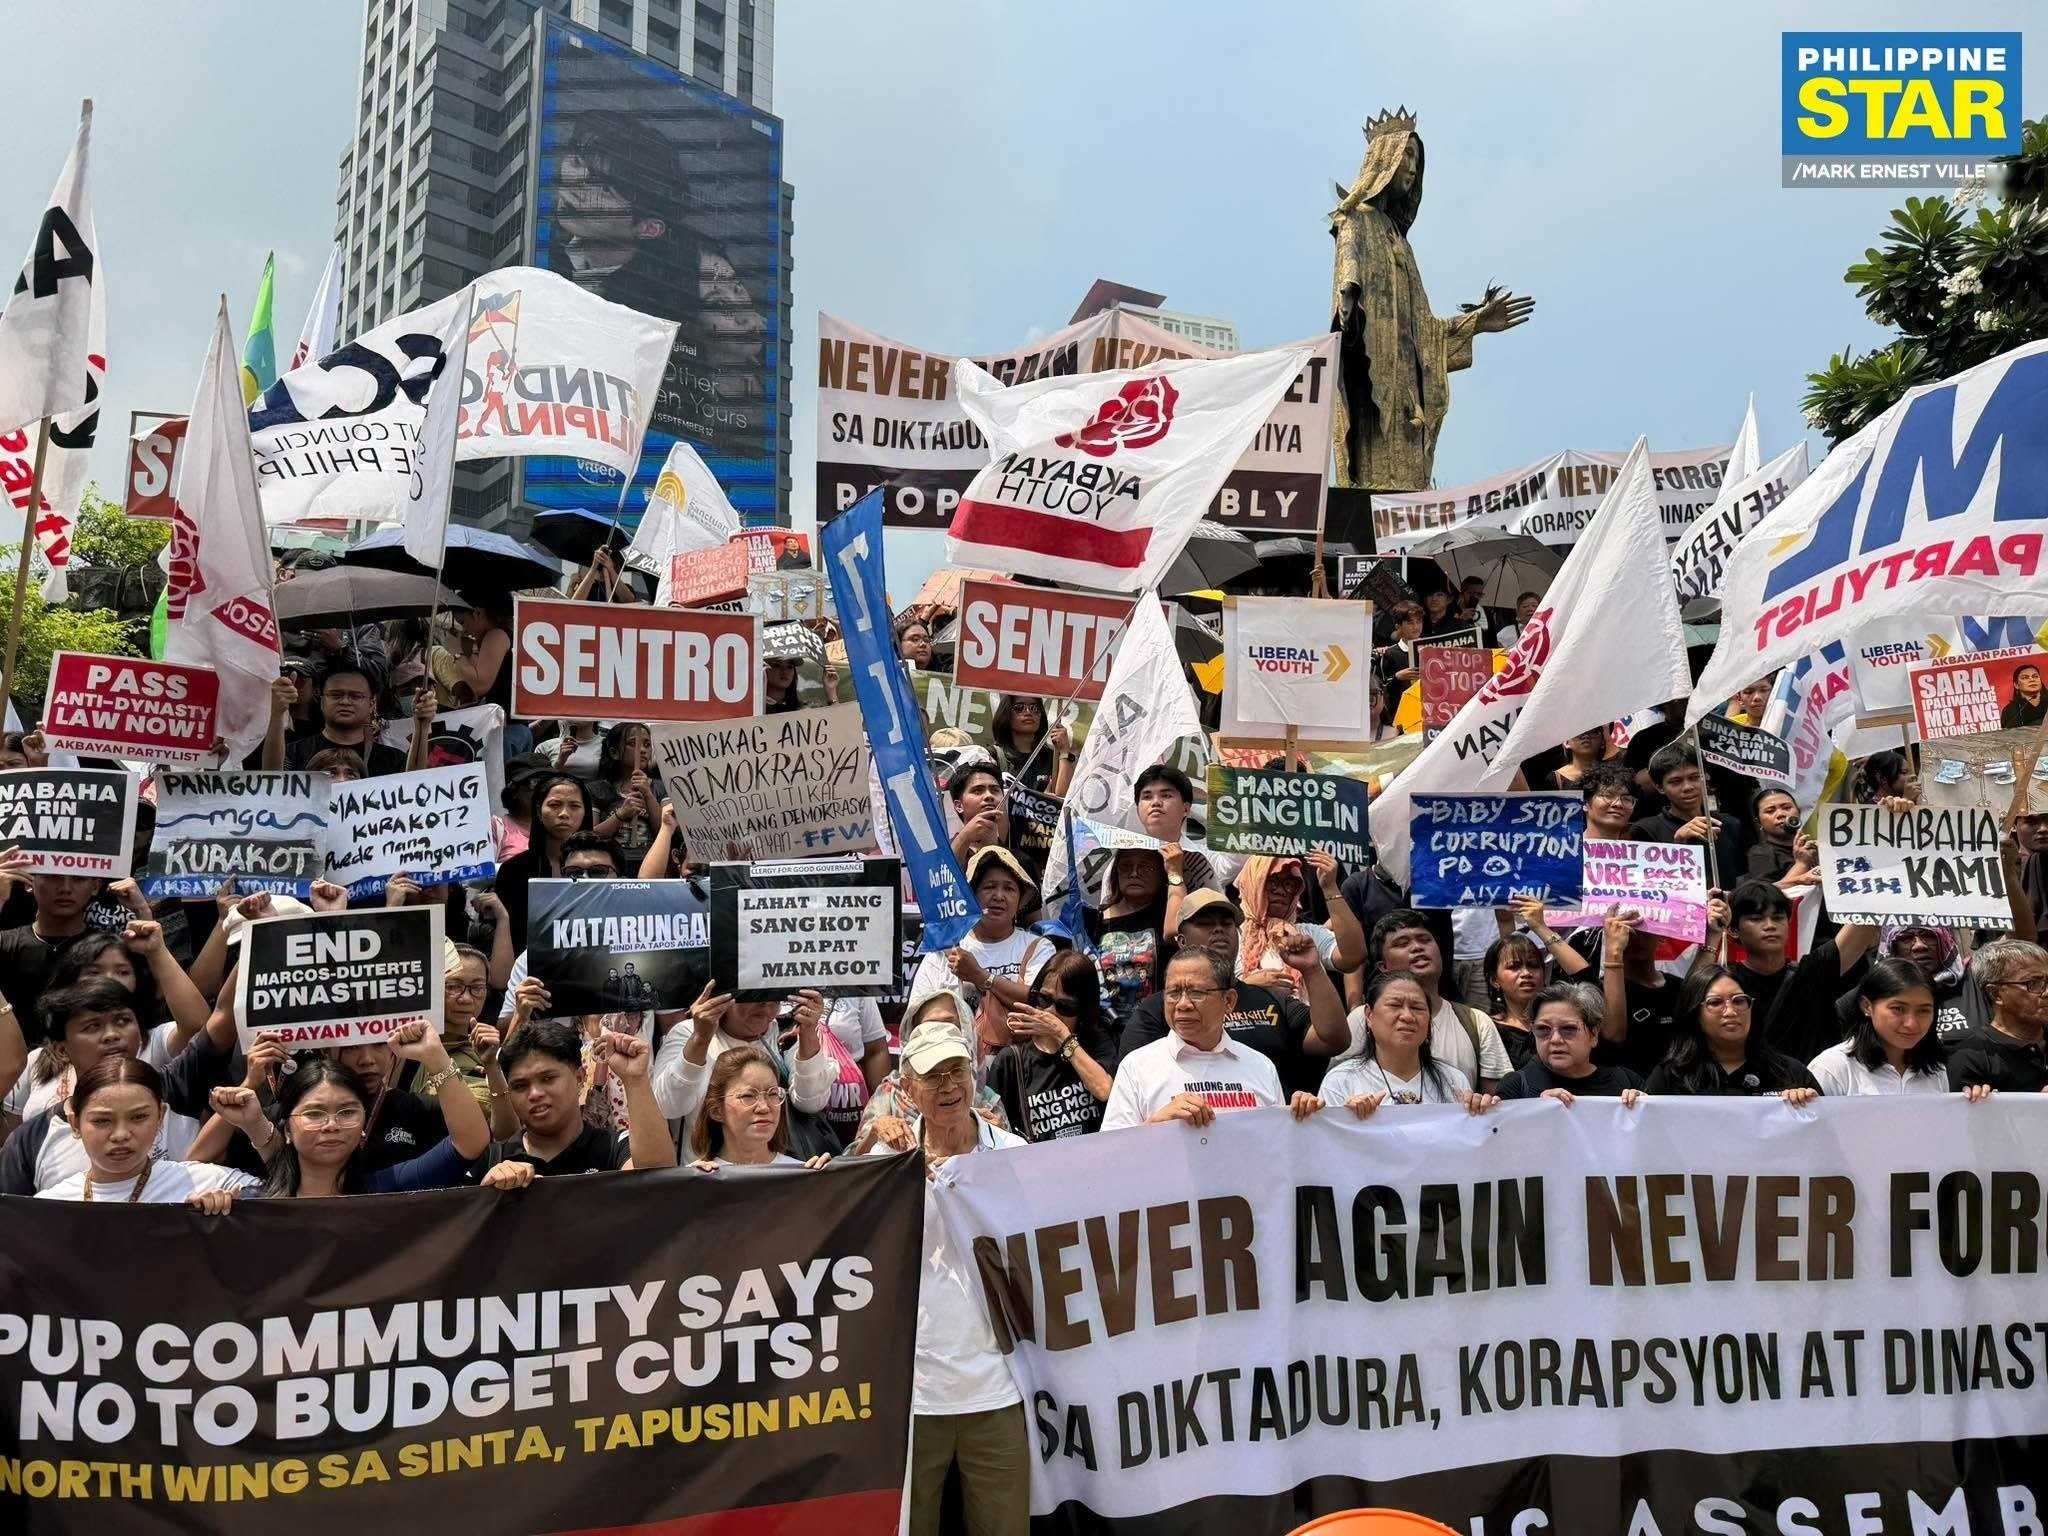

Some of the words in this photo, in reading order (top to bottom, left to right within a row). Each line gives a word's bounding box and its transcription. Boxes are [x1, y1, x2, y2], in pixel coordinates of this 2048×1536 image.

[818, 337, 950, 401] NEVER
[657, 412, 705, 435] SEPTEMBER
[690, 393, 748, 429] Yours
[832, 412, 864, 444] SA
[872, 416, 989, 451] DIKTADU
[1373, 501, 1456, 539] NEVER
[1465, 471, 1549, 519] AGAIN
[963, 600, 1128, 682] SENTR
[1248, 645, 1320, 662] LIBERAL
[1861, 640, 1924, 659] LIBERAL
[521, 621, 749, 704] SENTRO
[1254, 659, 1313, 674] YOUTH
[1868, 651, 1920, 668] YOUTH
[1931, 653, 1990, 668] AKBAYAN
[1993, 645, 2034, 659] PARTY
[86, 664, 189, 700] PASS
[1917, 667, 1995, 700] SARA,
[54, 691, 212, 719] ANTI-DYNASTY
[1921, 690, 1997, 711] IPALIWANAG
[55, 707, 120, 730] LAW
[125, 714, 206, 739] NOW!
[1923, 708, 1956, 729] MO
[1959, 702, 2000, 725] ANG
[661, 725, 768, 768] HUNGKAG
[777, 718, 828, 750] ANG
[1701, 718, 1786, 751] BINABAHA
[1718, 734, 1735, 747] PA
[1739, 739, 1764, 751] RIN
[1927, 723, 1977, 739] BILYONES
[54, 739, 124, 754] AKBAYAN
[127, 747, 200, 762] PARTYLIST
[1709, 739, 1775, 764] KAMI!
[669, 746, 860, 809] DEMOKRASYA
[1704, 752, 1746, 772] KBAYAN
[1750, 765, 1786, 781] YOUTH
[0, 782, 118, 803] NABAHA
[162, 774, 311, 799] PANAGUTIN
[1237, 776, 1337, 800] MARCOS
[35, 801, 77, 816] RIN
[685, 824, 720, 843] KUNG
[721, 814, 779, 841] WALANG
[782, 795, 872, 827] DEMOKRASYA
[1216, 795, 1359, 833] SINGILIN
[1431, 798, 1507, 825] BABY
[1511, 799, 1581, 829] STOP
[0, 816, 96, 842] AMI!
[1829, 807, 2002, 852] BINABAHA
[1430, 830, 1581, 859] CORRUPTION
[1644, 845, 1696, 866] OUR
[51, 854, 112, 870] YOUTH
[165, 844, 316, 877] KURAKOT
[751, 867, 777, 875] CLERGY
[816, 863, 863, 872] GOVERNANCE
[1836, 857, 1874, 874] PA
[1643, 866, 1702, 886] BACK!
[1836, 877, 1904, 897] RIN
[743, 896, 810, 910] LAHAT
[826, 895, 882, 908] NANG
[1832, 911, 1914, 926] AKBAYAN
[286, 929, 382, 967] END
[610, 943, 633, 952] HINDI
[634, 943, 647, 951] PA
[648, 941, 676, 949] TAPOS
[677, 938, 695, 947] ANG
[788, 940, 858, 954] DAPAT
[255, 960, 422, 986] MARCOS-DUTERTE
[762, 960, 880, 978] MANAGOT
[253, 976, 425, 1010] DYNASTIES!
[1027, 1081, 1087, 1108] IKULON
[1184, 1081, 1224, 1092] IKULONG
[1224, 1082, 1243, 1093] ang
[1029, 1102, 1063, 1122] ANG
[972, 1194, 1260, 1356] NEVER
[1295, 1175, 1547, 1305] AGAIN
[1585, 1173, 1856, 1287] NEVER
[134, 1280, 664, 1384] COMMUNITY
[678, 1254, 875, 1332] SAYS
[18, 1380, 137, 1442] NO
[145, 1383, 260, 1448] TO
[275, 1347, 603, 1441] BUDGET
[615, 1314, 842, 1395] CUTS!
[1032, 1388, 1098, 1473] SA
[1118, 1352, 1442, 1470] DIKTADURA,
[1458, 1331, 1781, 1417] KORAPSYON
[1799, 1329, 1865, 1399] AT
[0, 1458, 154, 1502] NORTH
[162, 1456, 309, 1504] WING
[318, 1448, 391, 1490] SA
[398, 1425, 567, 1478] SINTA,
[575, 1399, 781, 1454] TAPUSIN
[789, 1382, 874, 1429] NA!
[1626, 1484, 2045, 1536] ASSEMB
